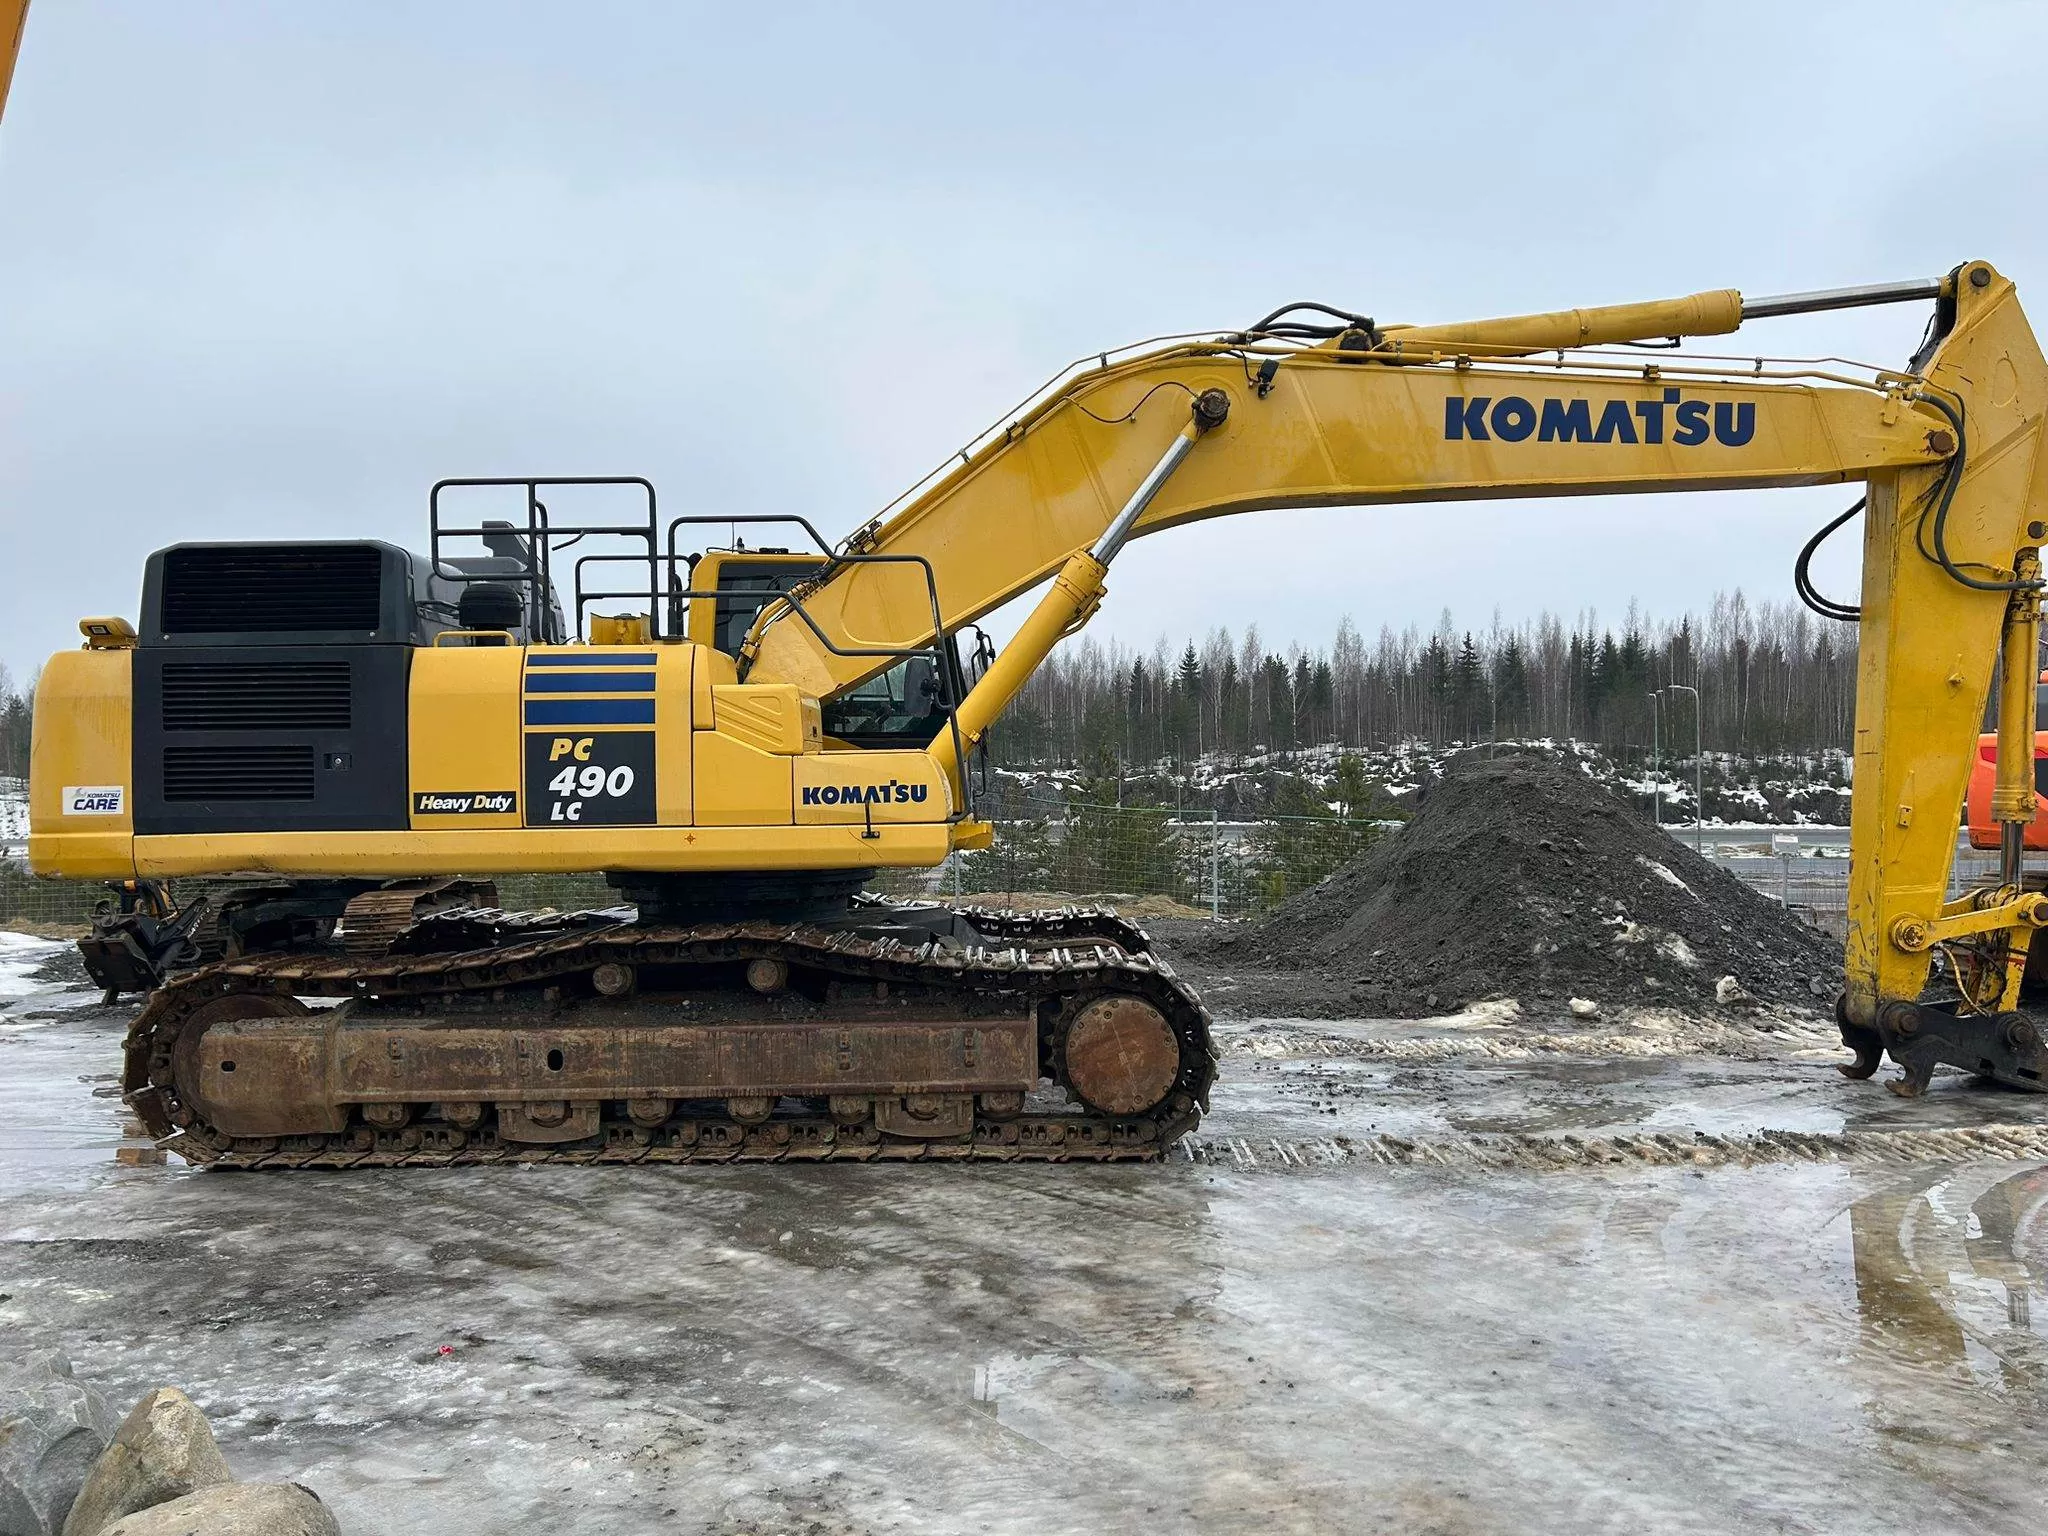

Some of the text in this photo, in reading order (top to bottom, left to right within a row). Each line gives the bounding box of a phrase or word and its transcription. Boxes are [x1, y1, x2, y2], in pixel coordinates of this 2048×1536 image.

[1445, 388, 1756, 447] KOMATSU
[549, 738, 593, 761] PC
[549, 765, 635, 798] 490
[802, 779, 927, 805] KOMATSU
[73, 798, 119, 811] CARE
[420, 795, 512, 813] Heavy Duty
[550, 801, 582, 821] LC
